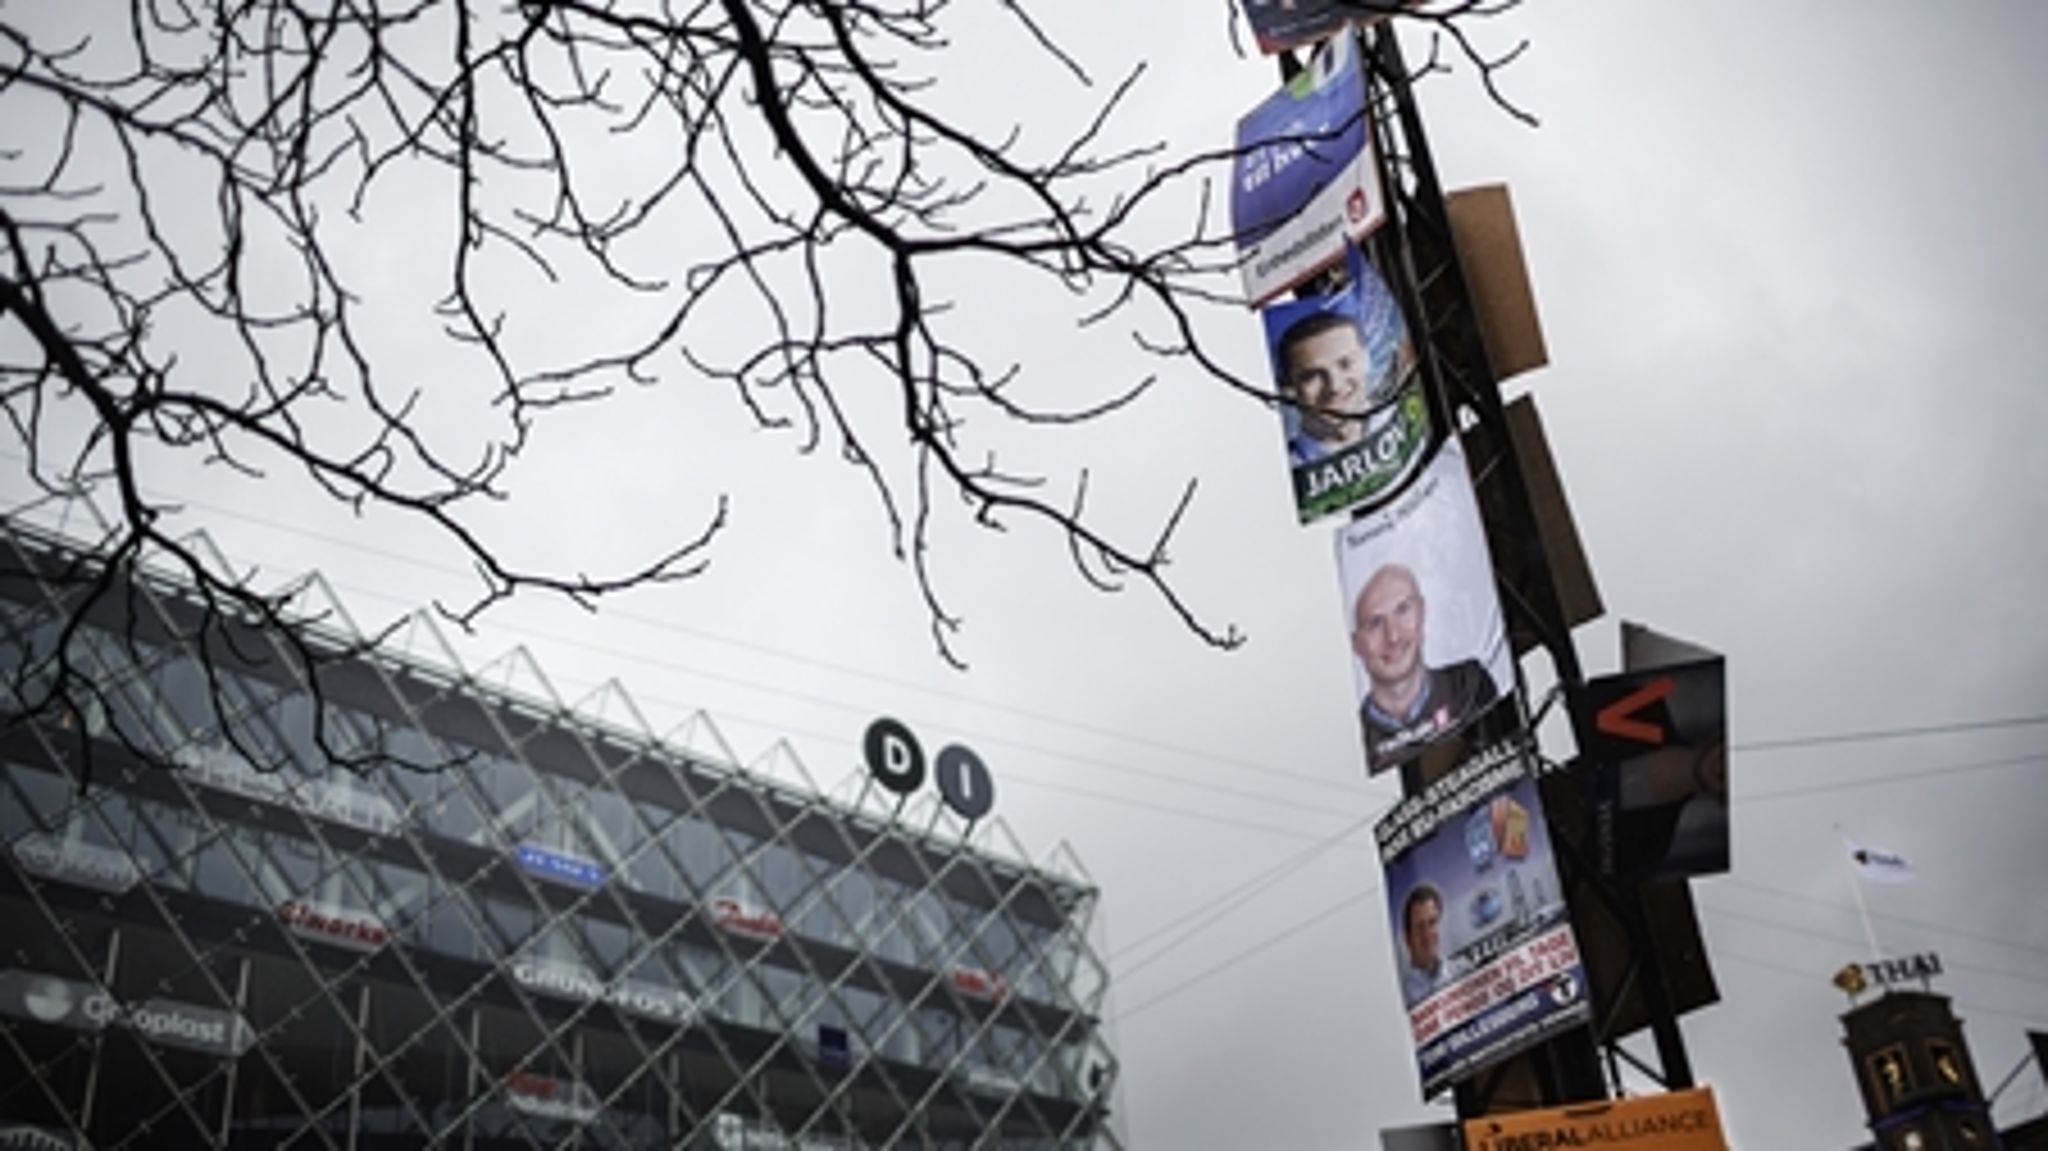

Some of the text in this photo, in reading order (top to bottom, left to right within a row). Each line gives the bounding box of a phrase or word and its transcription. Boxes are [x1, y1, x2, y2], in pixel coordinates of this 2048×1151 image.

[884, 733, 972, 800] D I
[1866, 952, 1943, 985] THAI
